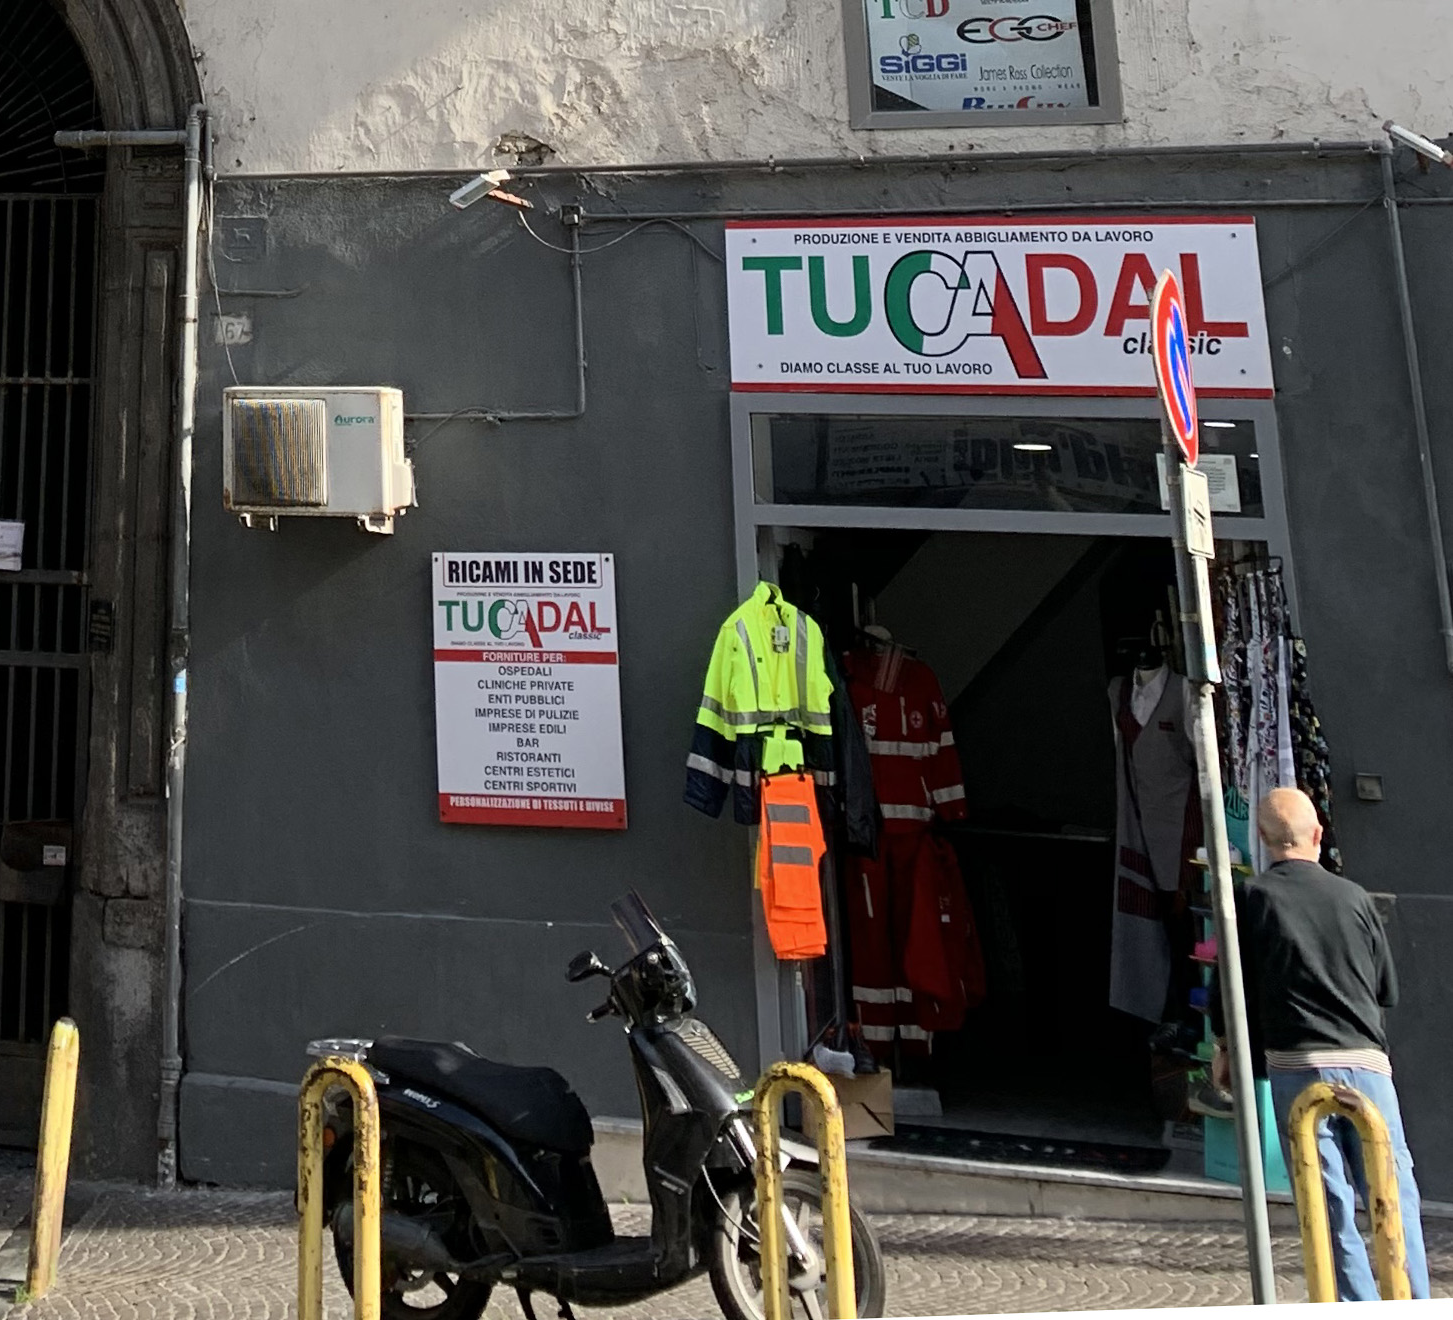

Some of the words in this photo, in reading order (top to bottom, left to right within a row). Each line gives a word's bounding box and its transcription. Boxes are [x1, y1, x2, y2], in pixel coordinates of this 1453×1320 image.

[1036, 22, 1077, 31] CHEF
[979, 65, 1007, 81] James
[1030, 63, 1073, 79] Collection
[794, 233, 879, 245] PRODUZIONE
[883, 233, 891, 244] E
[895, 232, 953, 244] VENDITA
[954, 231, 1068, 243] ABBIGLIAMENTO
[1072, 231, 1092, 242] DA
[1095, 230, 1154, 242] LAVORO
[742, 250, 1250, 379] TUCADAL
[780, 362, 823, 374] DIAMO
[827, 362, 879, 374] CLASSE
[883, 363, 900, 374] AL
[903, 363, 932, 374] TUO
[935, 363, 993, 375] LAVORO
[334, 414, 375, 424] Aurora
[448, 560, 518, 584] RICAMI
[524, 561, 544, 584] IN
[548, 560, 597, 584] SEDE
[438, 599, 611, 648] TUCADAL
[568, 632, 603, 641] classic
[482, 651, 540, 663] FORNITURE
[498, 666, 552, 676] OSPEDALI
[477, 680, 526, 690] CLINICHE
[530, 681, 574, 691] PRIVATE
[488, 694, 512, 704] ENTI
[515, 695, 565, 705] PUBBLICI
[475, 708, 521, 719] IMPRESE
[525, 709, 535, 719] DI
[538, 709, 579, 720] PULIZIE
[488, 723, 536, 733] IMPRESE
[539, 723, 566, 734] EDILI
[516, 738, 539, 748] BAR
[496, 751, 561, 763] RISTORANTI
[484, 766, 524, 777] CENTRI
[527, 767, 575, 778] ESTETICI
[484, 780, 524, 791] CENTRI
[526, 781, 577, 793] SPORTIVI
[450, 796, 531, 810] PERSONALIZZAZIONE
[545, 799, 578, 811] TESSUTI
[579, 800, 585, 811] E
